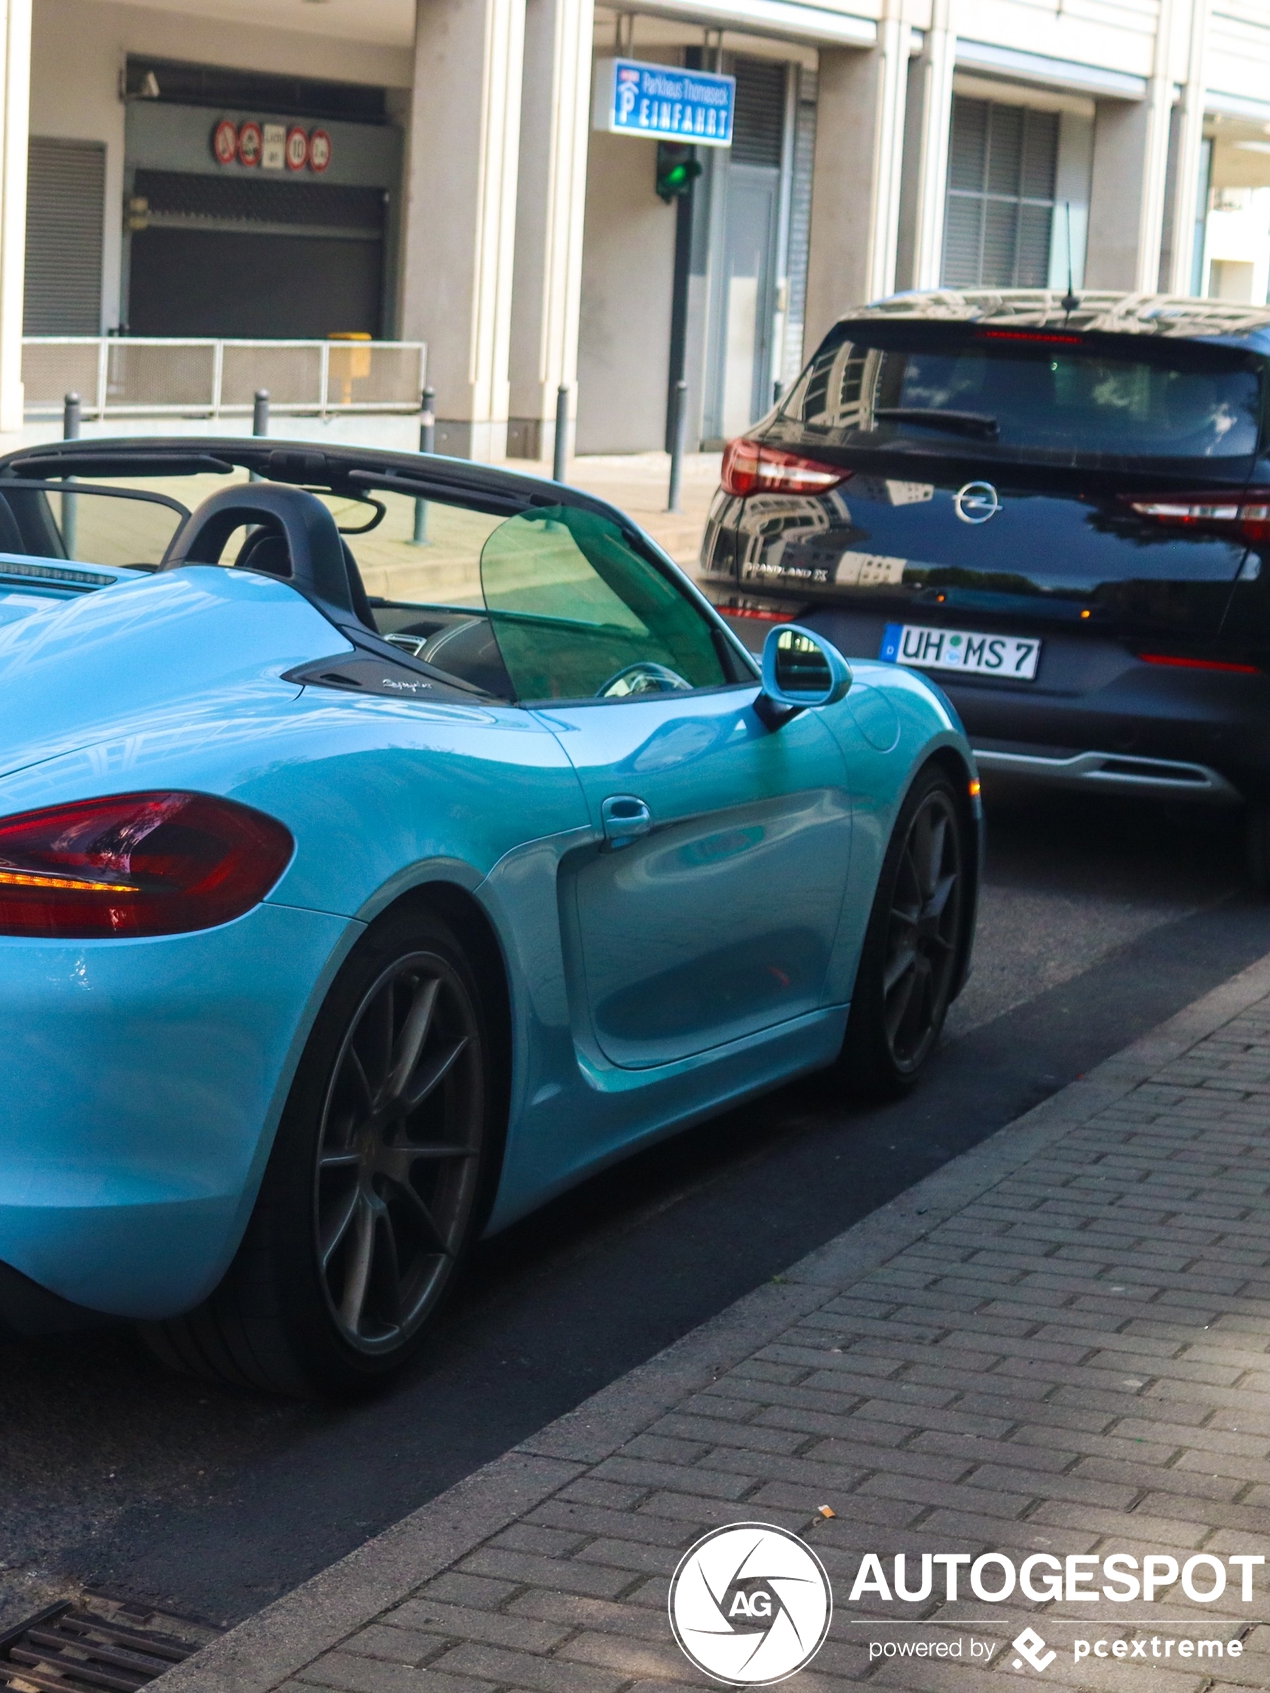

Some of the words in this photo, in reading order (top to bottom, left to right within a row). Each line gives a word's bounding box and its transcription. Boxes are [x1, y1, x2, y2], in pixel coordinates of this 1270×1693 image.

[643, 72, 682, 100] Parkhaus
[639, 98, 728, 137] EINFAHRT
[293, 139, 305, 158] 10
[902, 630, 945, 661] UH
[963, 636, 1007, 668] MS
[1015, 642, 1035, 671] 7
